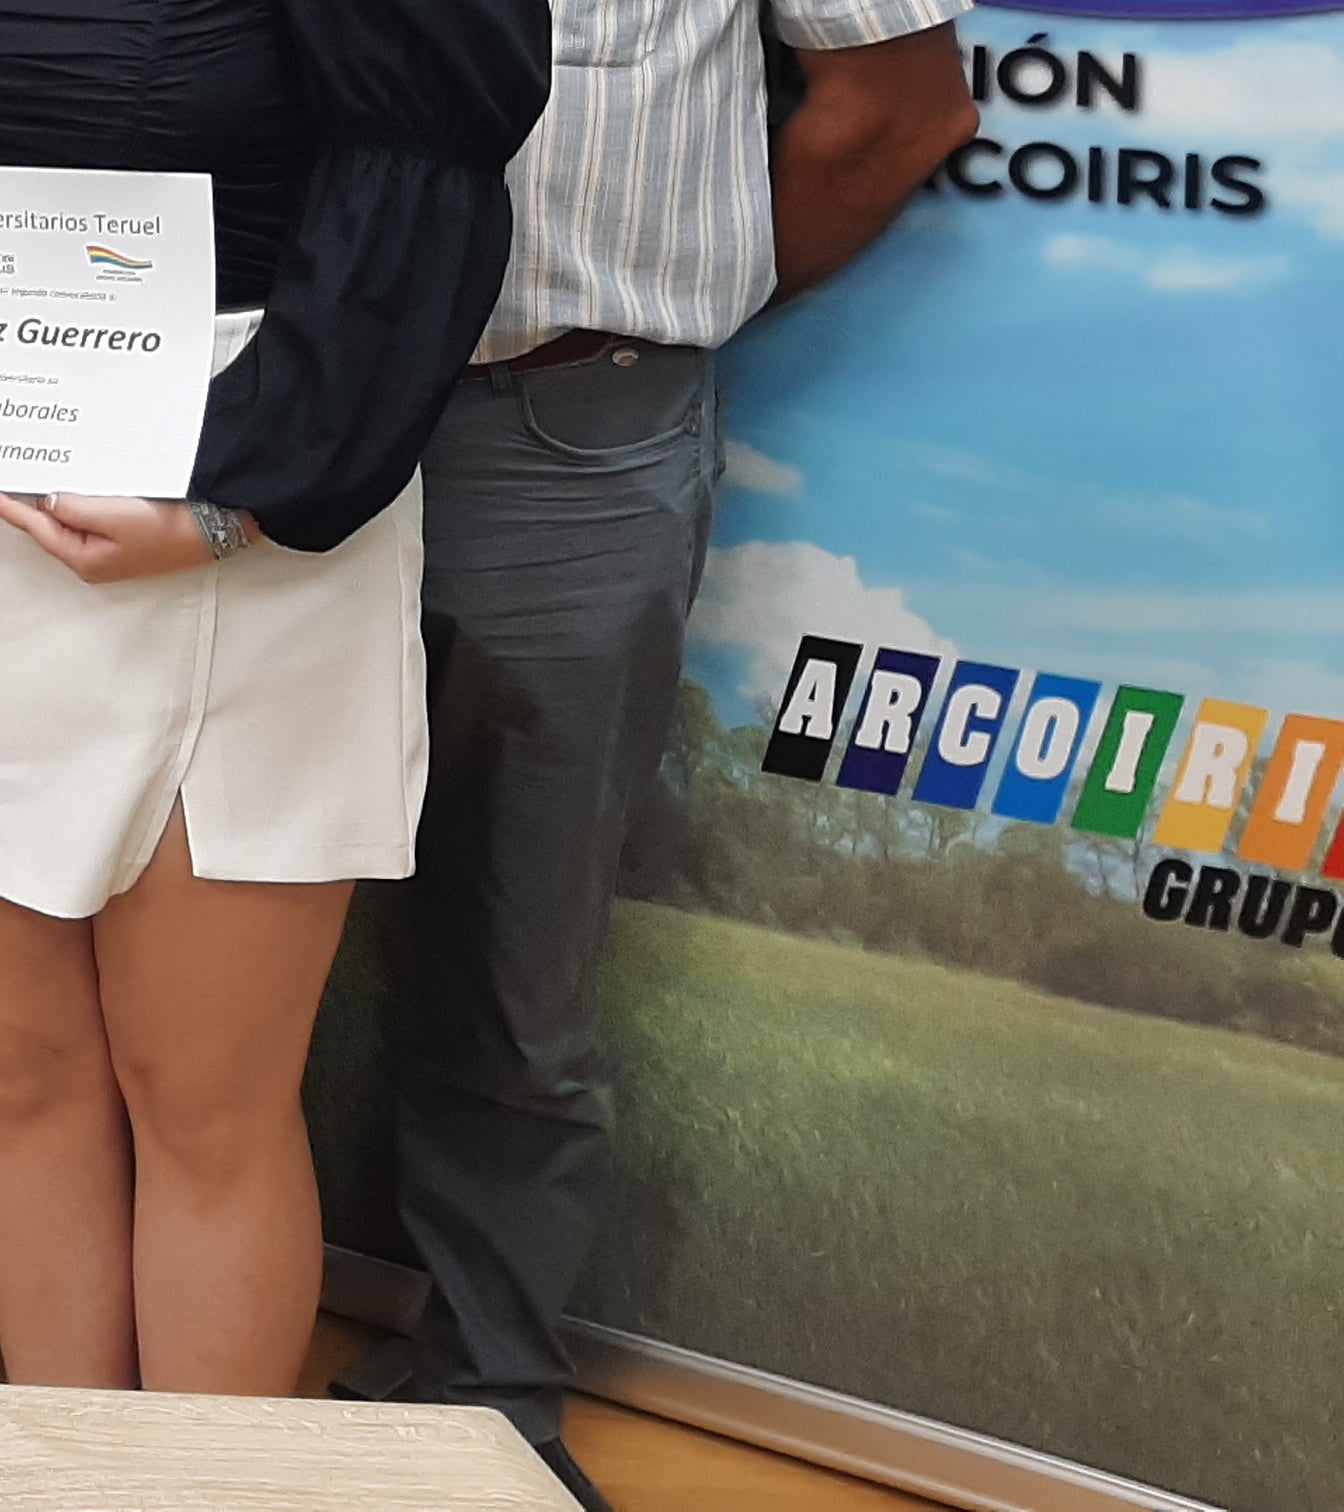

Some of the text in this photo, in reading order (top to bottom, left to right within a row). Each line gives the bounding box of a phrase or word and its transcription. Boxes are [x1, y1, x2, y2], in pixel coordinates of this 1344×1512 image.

[972, 33, 1137, 111] IÓN
[924, 137, 1265, 214] COIRIS
[94, 214, 161, 236] Teruel
[17, 318, 161, 353] Guerrero
[779, 658, 1344, 824] ARCOIRI
[1143, 859, 1344, 961] GRUP
